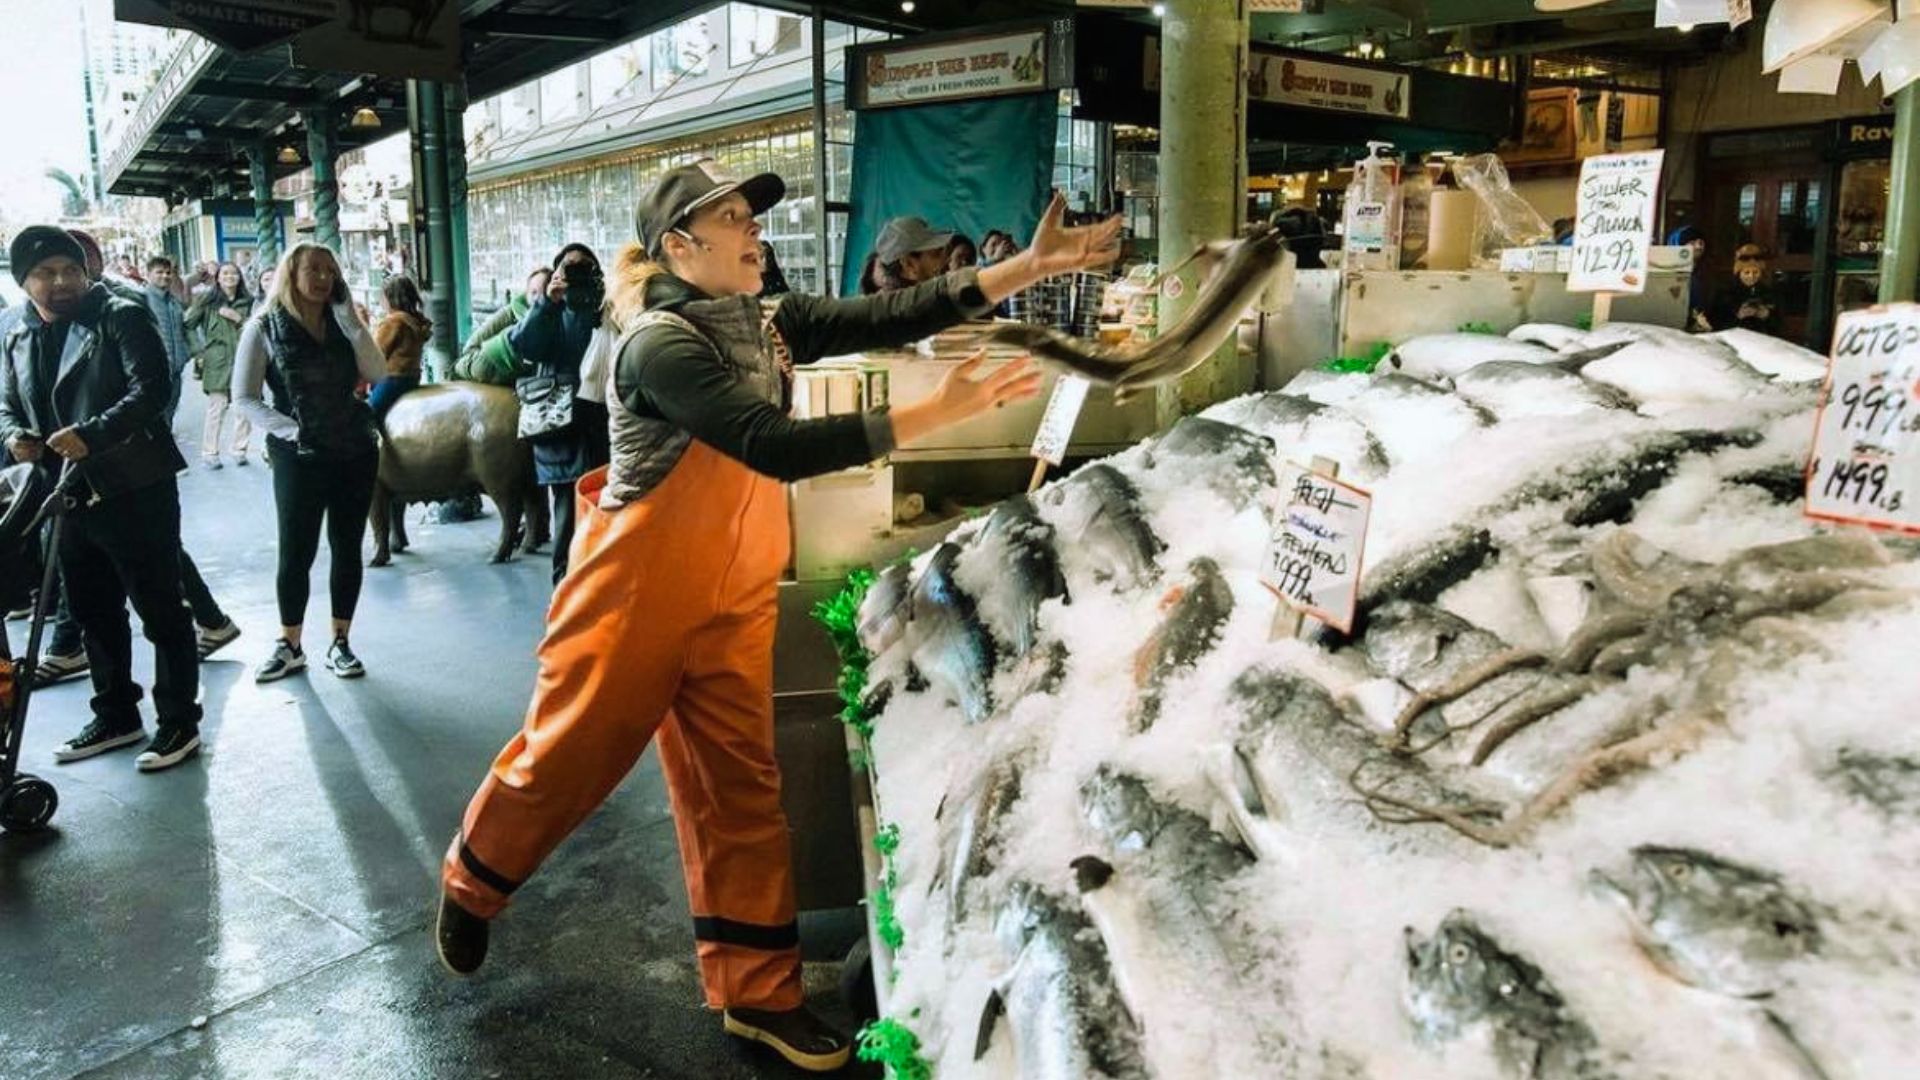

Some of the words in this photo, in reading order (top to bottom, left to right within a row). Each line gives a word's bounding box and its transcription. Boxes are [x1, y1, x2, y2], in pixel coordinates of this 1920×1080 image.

[171, 2, 248, 24] DONATE
[936, 58, 966, 76] THE
[1584, 174, 1648, 200] SILVER
